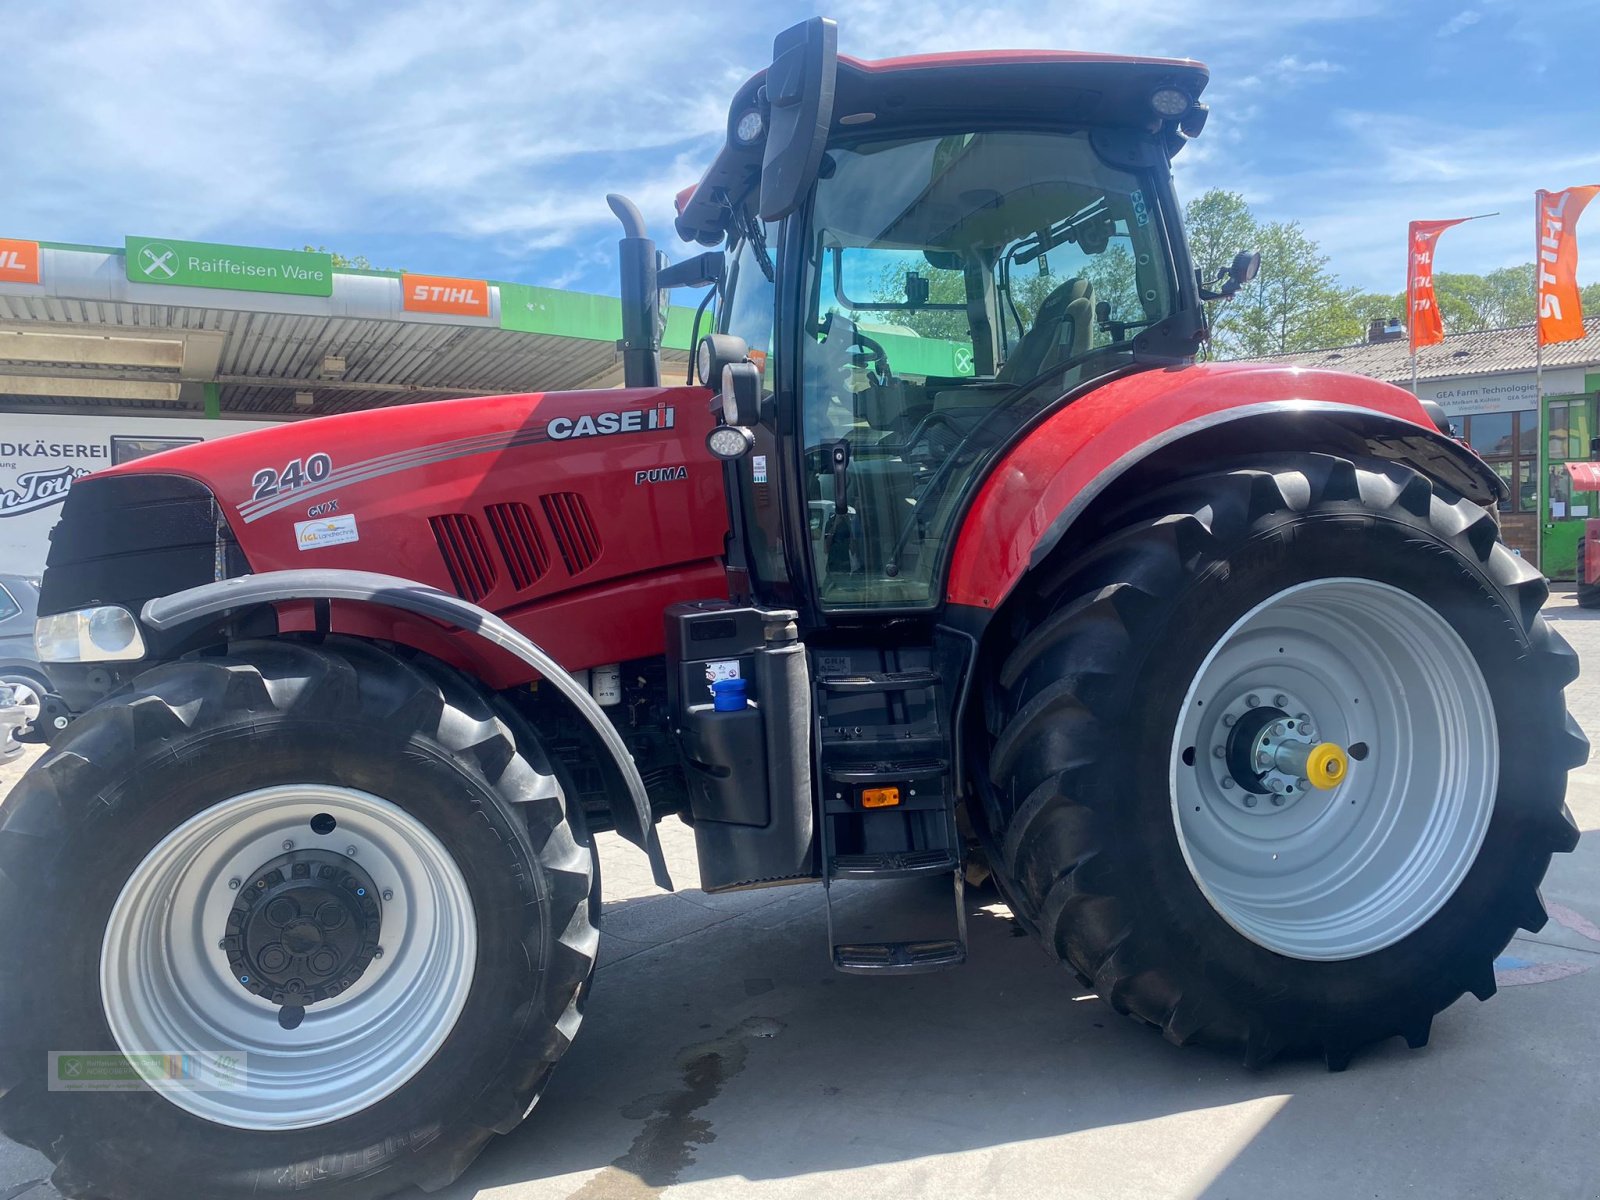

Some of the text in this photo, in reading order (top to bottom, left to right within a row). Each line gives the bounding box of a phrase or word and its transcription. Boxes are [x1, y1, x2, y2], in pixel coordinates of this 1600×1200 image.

[1540, 192, 1570, 320] STIHL
[188, 256, 324, 281] Raiffeisen Ware
[413, 285, 480, 304] STIHL
[1436, 391, 1454, 399] GEA
[1456, 389, 1478, 397] Farm
[547, 410, 642, 440] CASE
[1, 440, 108, 458] DKÄSEREI
[252, 452, 332, 502] 240
[635, 466, 689, 485] PUMA
[307, 499, 339, 518] CVX
